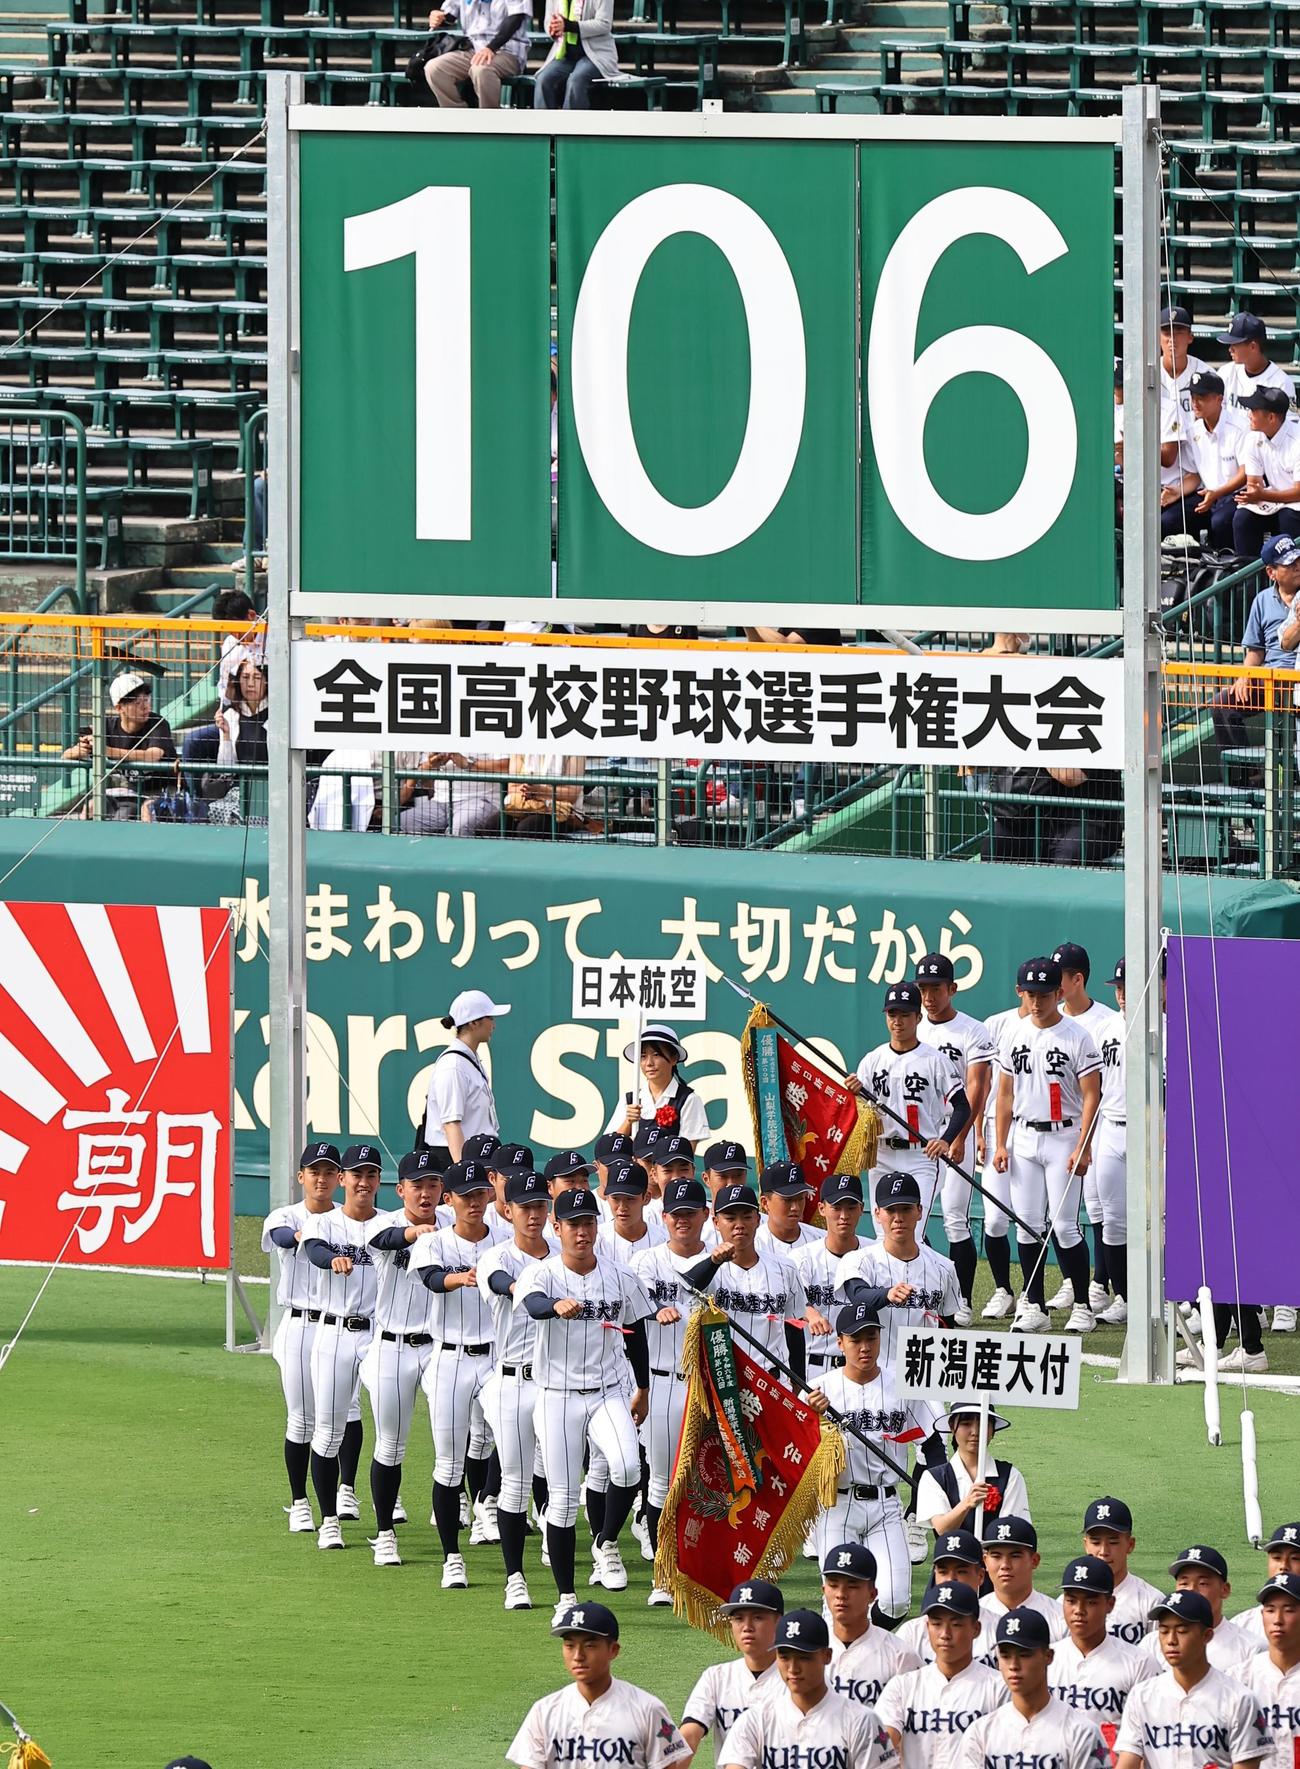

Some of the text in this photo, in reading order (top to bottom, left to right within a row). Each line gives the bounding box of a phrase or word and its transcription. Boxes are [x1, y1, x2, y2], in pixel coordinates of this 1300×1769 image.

[344, 183, 1078, 561] 106
[313, 658, 1106, 755] 全国高校野球選手権大会
[661, 896, 984, 992] 大切だから
[581, 965, 696, 1009] 日本航空
[1010, 1044, 1070, 1078] 航空
[871, 1069, 930, 1104] 航空
[57, 1088, 223, 1258] 朝
[904, 1334, 1071, 1396] 新潟産大付
[903, 1707, 984, 1735] NIHO
[1144, 1721, 1230, 1753] NIHON
[552, 1734, 637, 1765] NIHON
